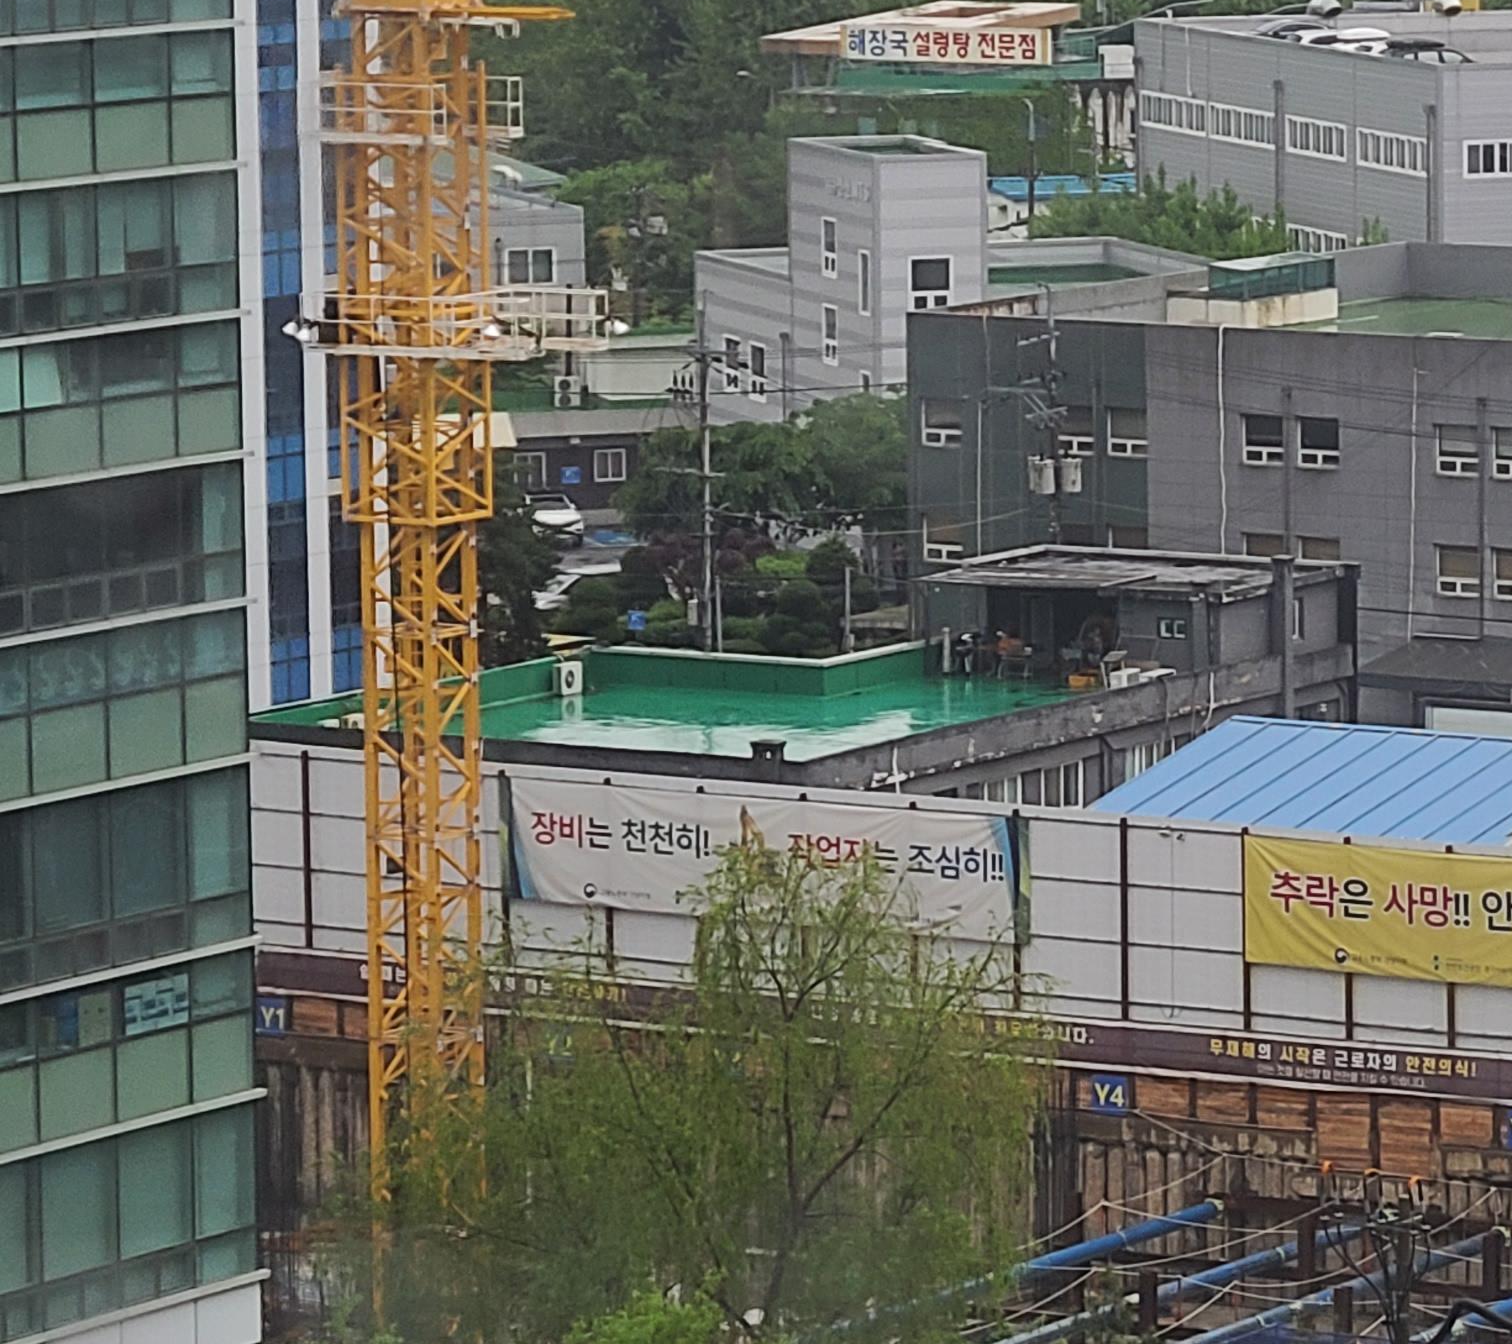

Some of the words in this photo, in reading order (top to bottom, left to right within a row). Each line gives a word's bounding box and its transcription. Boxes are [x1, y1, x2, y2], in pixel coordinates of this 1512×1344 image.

[848, 29, 909, 57] 해장국
[912, 31, 971, 58] 설렁탕
[977, 32, 1036, 60] 전문점
[531, 812, 612, 849] 장비는
[621, 819, 710, 859] 천천히!
[907, 845, 1004, 883] 조심히!!
[1270, 871, 1373, 919] 추락은
[1383, 883, 1471, 928] 사망!!
[261, 1006, 285, 1029] Y1
[1210, 1039, 1272, 1059] 무재해의
[1280, 1044, 1327, 1066] 시작은
[1335, 1049, 1397, 1071] 근로자의
[1405, 1056, 1478, 1077] 안전의식!
[1094, 1082, 1124, 1107] Y4
